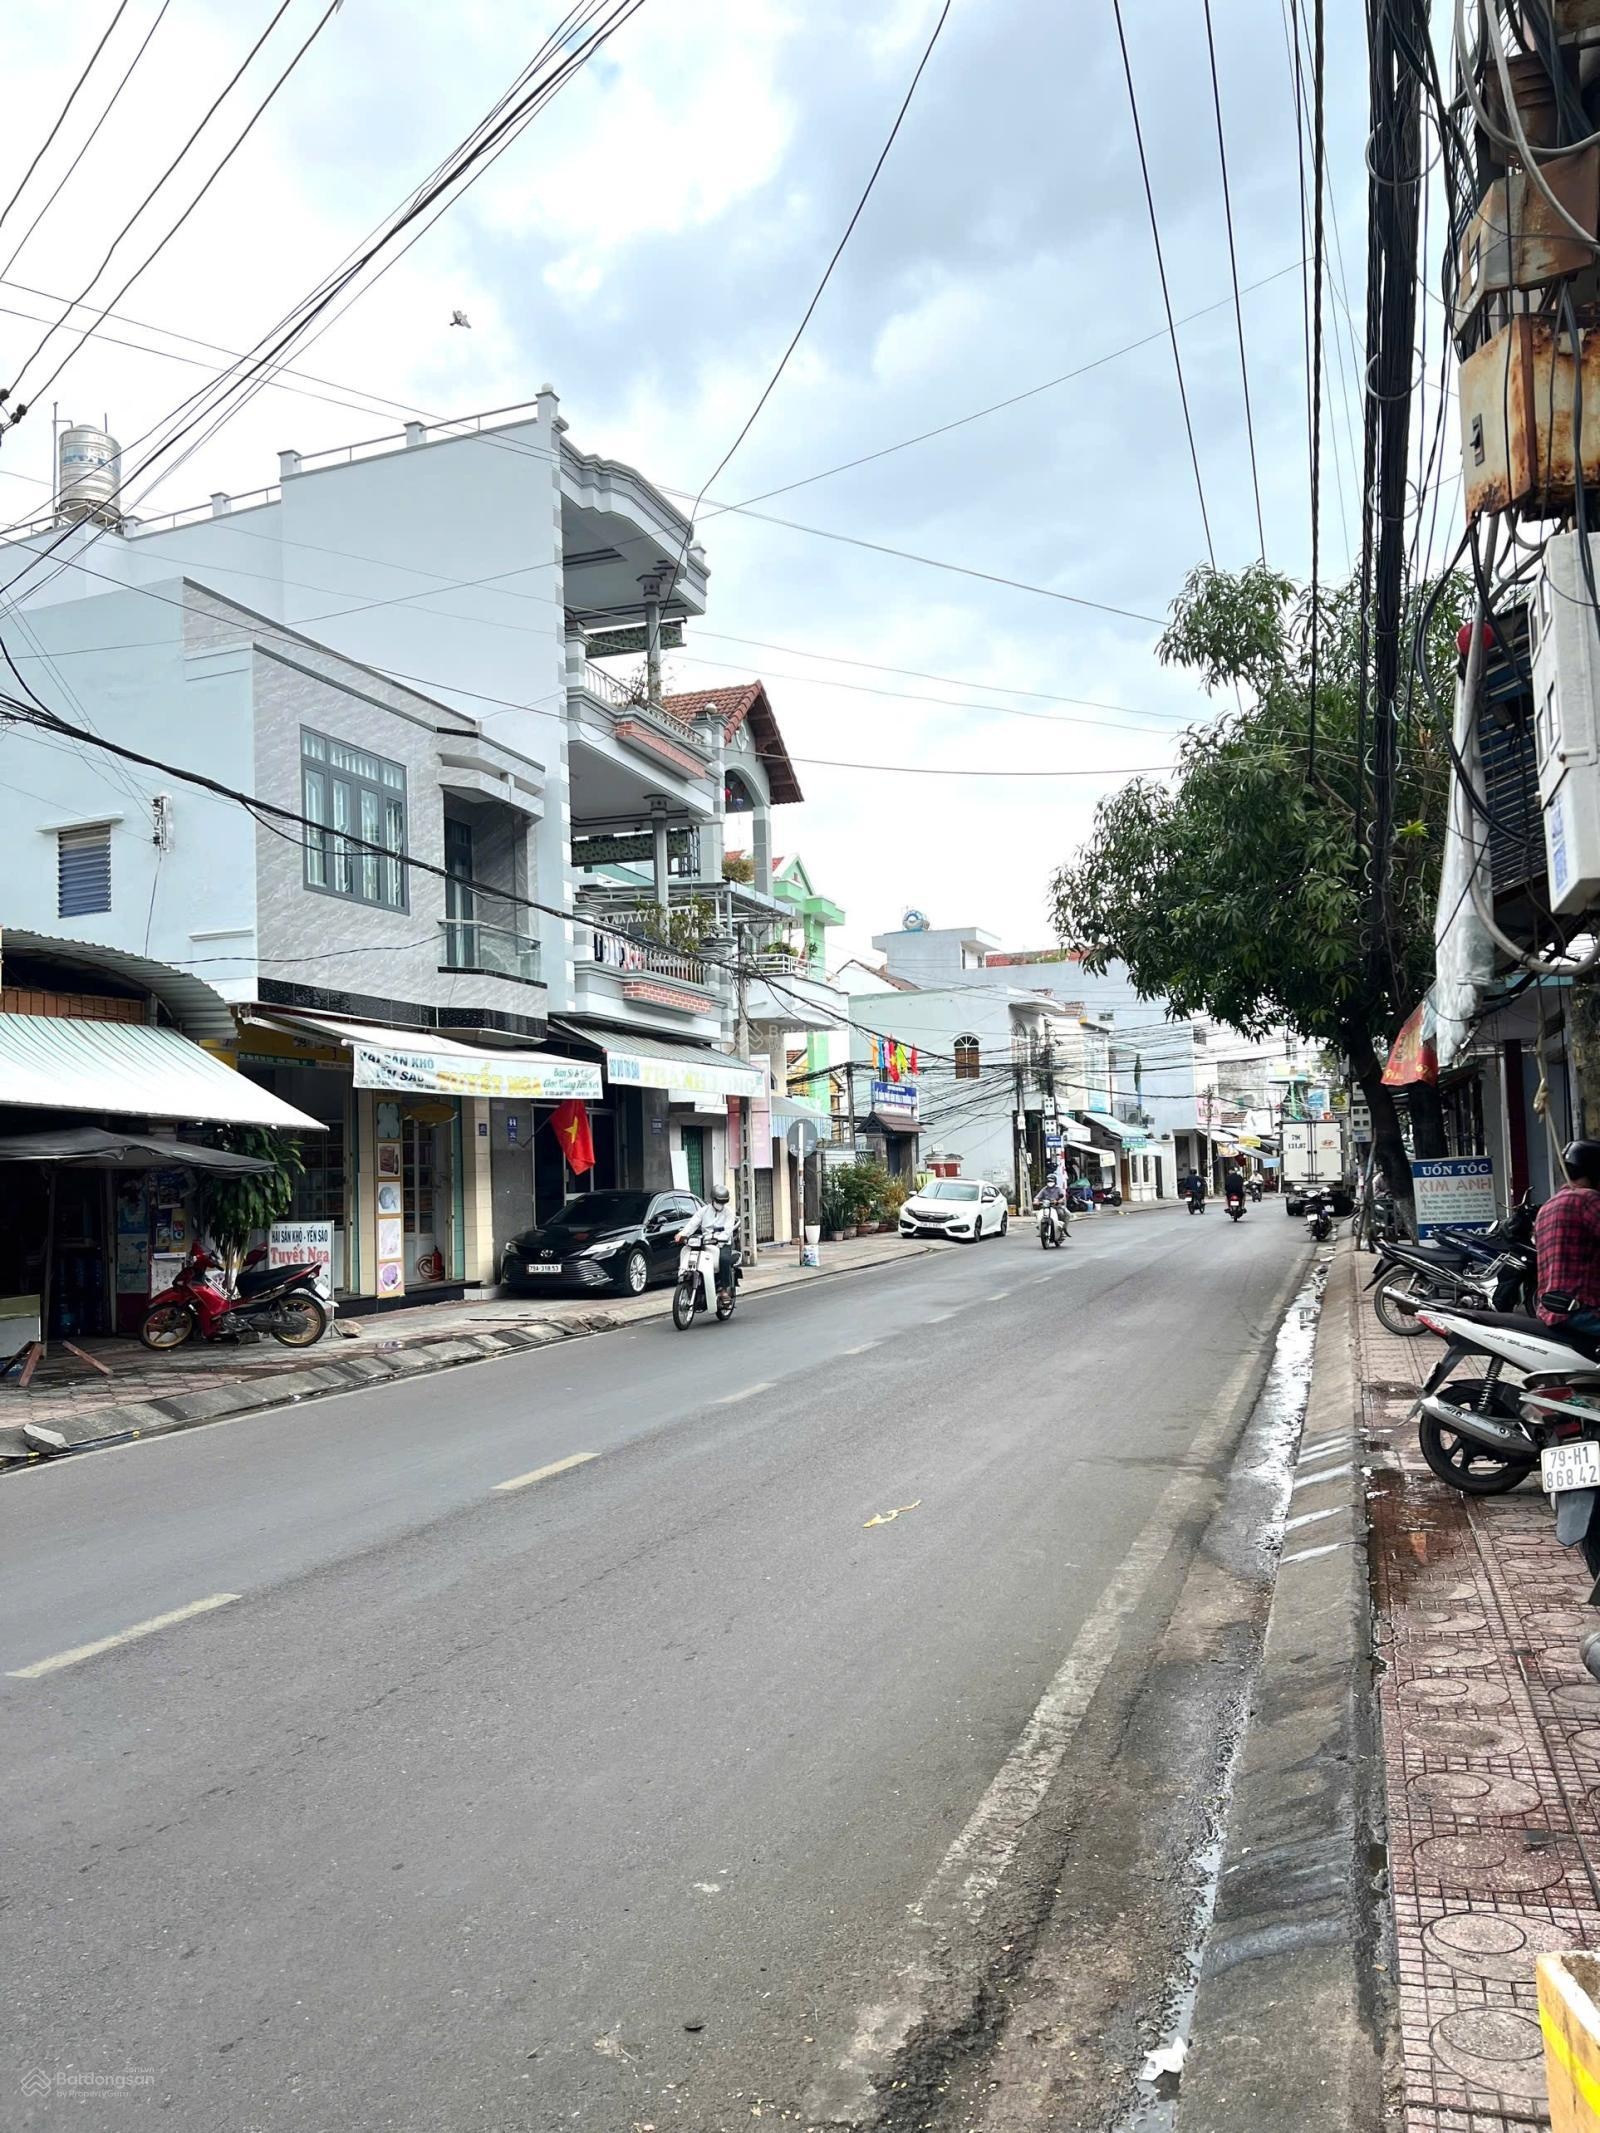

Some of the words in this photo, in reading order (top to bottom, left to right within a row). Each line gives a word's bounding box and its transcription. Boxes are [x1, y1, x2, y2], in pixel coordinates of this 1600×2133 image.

[411, 1056, 435, 1070] KHÔ
[1422, 1162, 1453, 1176] UỐN
[1457, 1162, 1489, 1174] TÓC
[1418, 1179, 1450, 1192] KIM
[1456, 1178, 1492, 1191] ANH
[271, 1225, 280, 1243] HẢI
[281, 1225, 291, 1243] SẢN
[292, 1226, 303, 1243] KHÔ
[306, 1225, 317, 1242] YẾN
[271, 1243, 304, 1264] Tuyết
[307, 1246, 329, 1264] Nga
[1550, 1446, 1590, 1470] 79-H1
[1546, 1465, 1598, 1489] 868.42
